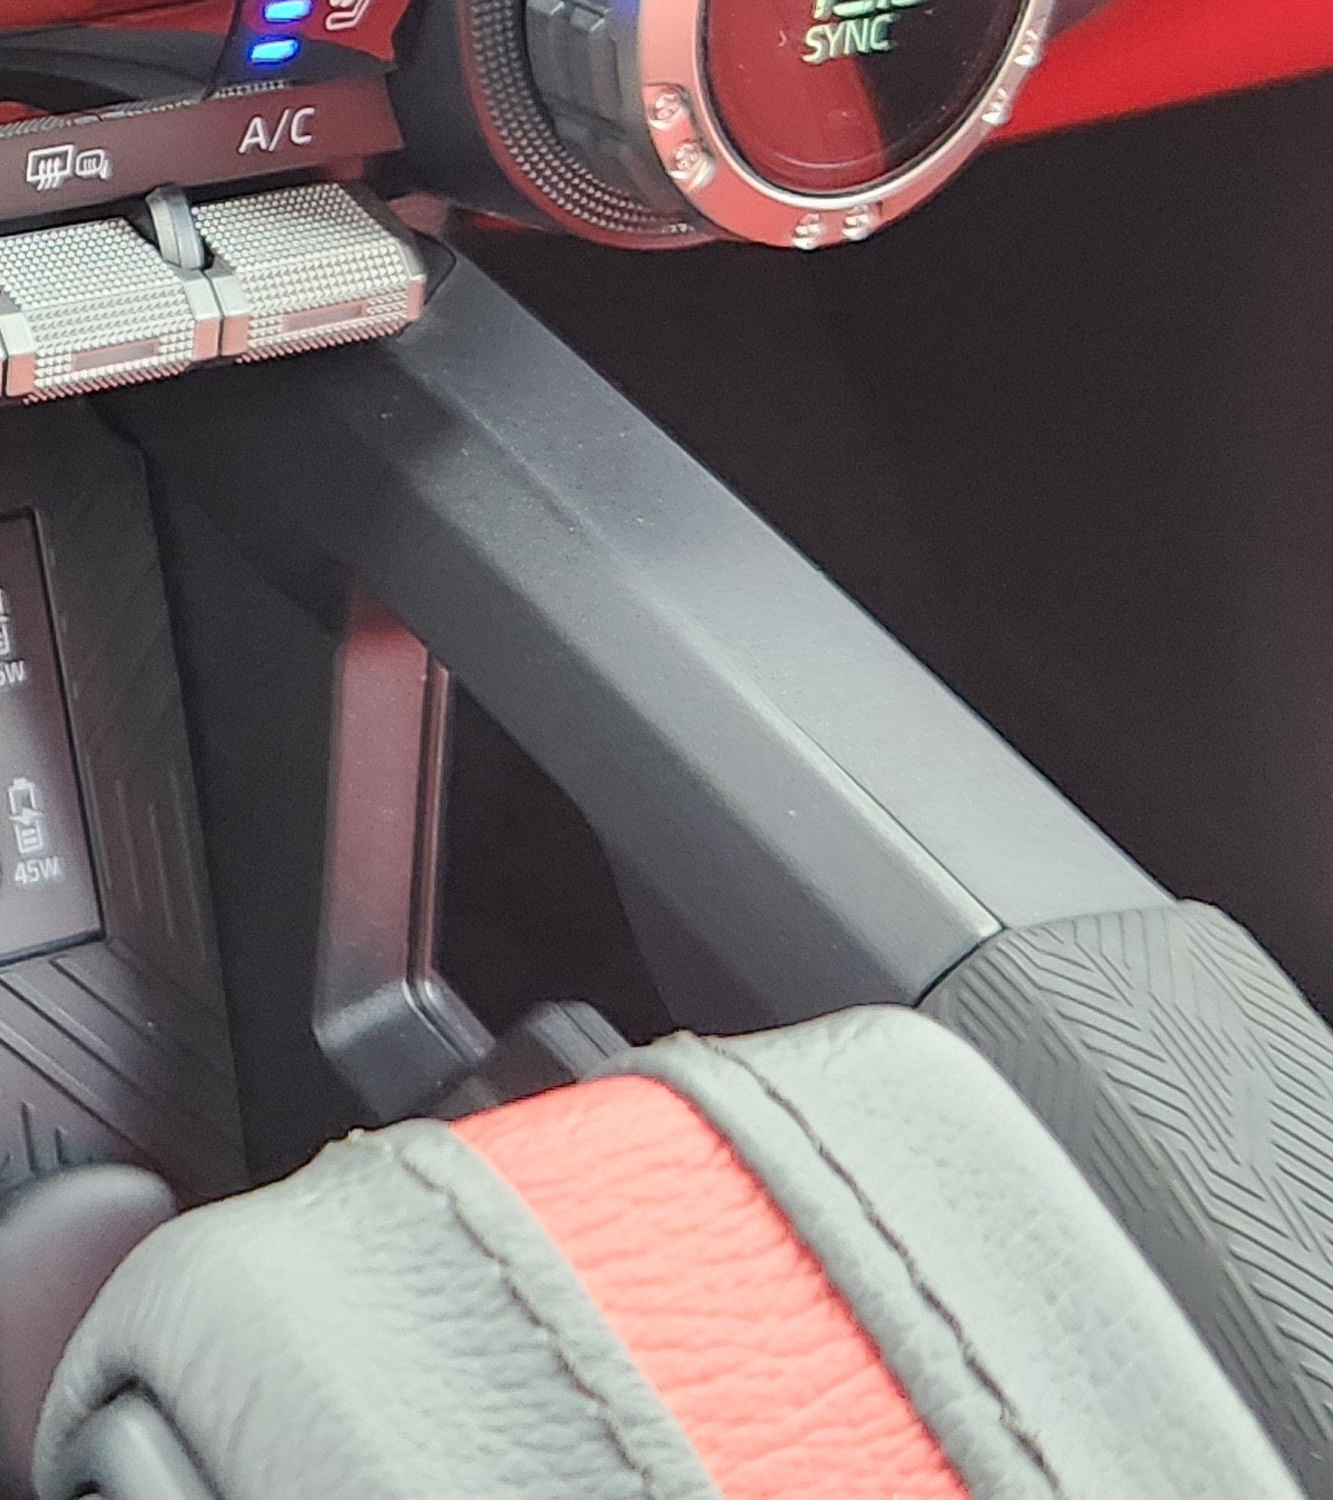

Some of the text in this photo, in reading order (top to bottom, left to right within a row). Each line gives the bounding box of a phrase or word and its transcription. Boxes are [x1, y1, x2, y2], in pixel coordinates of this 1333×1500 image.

[802, 13, 897, 64] SYNC
[237, 106, 315, 154] A/C
[14, 856, 62, 885] 45W
